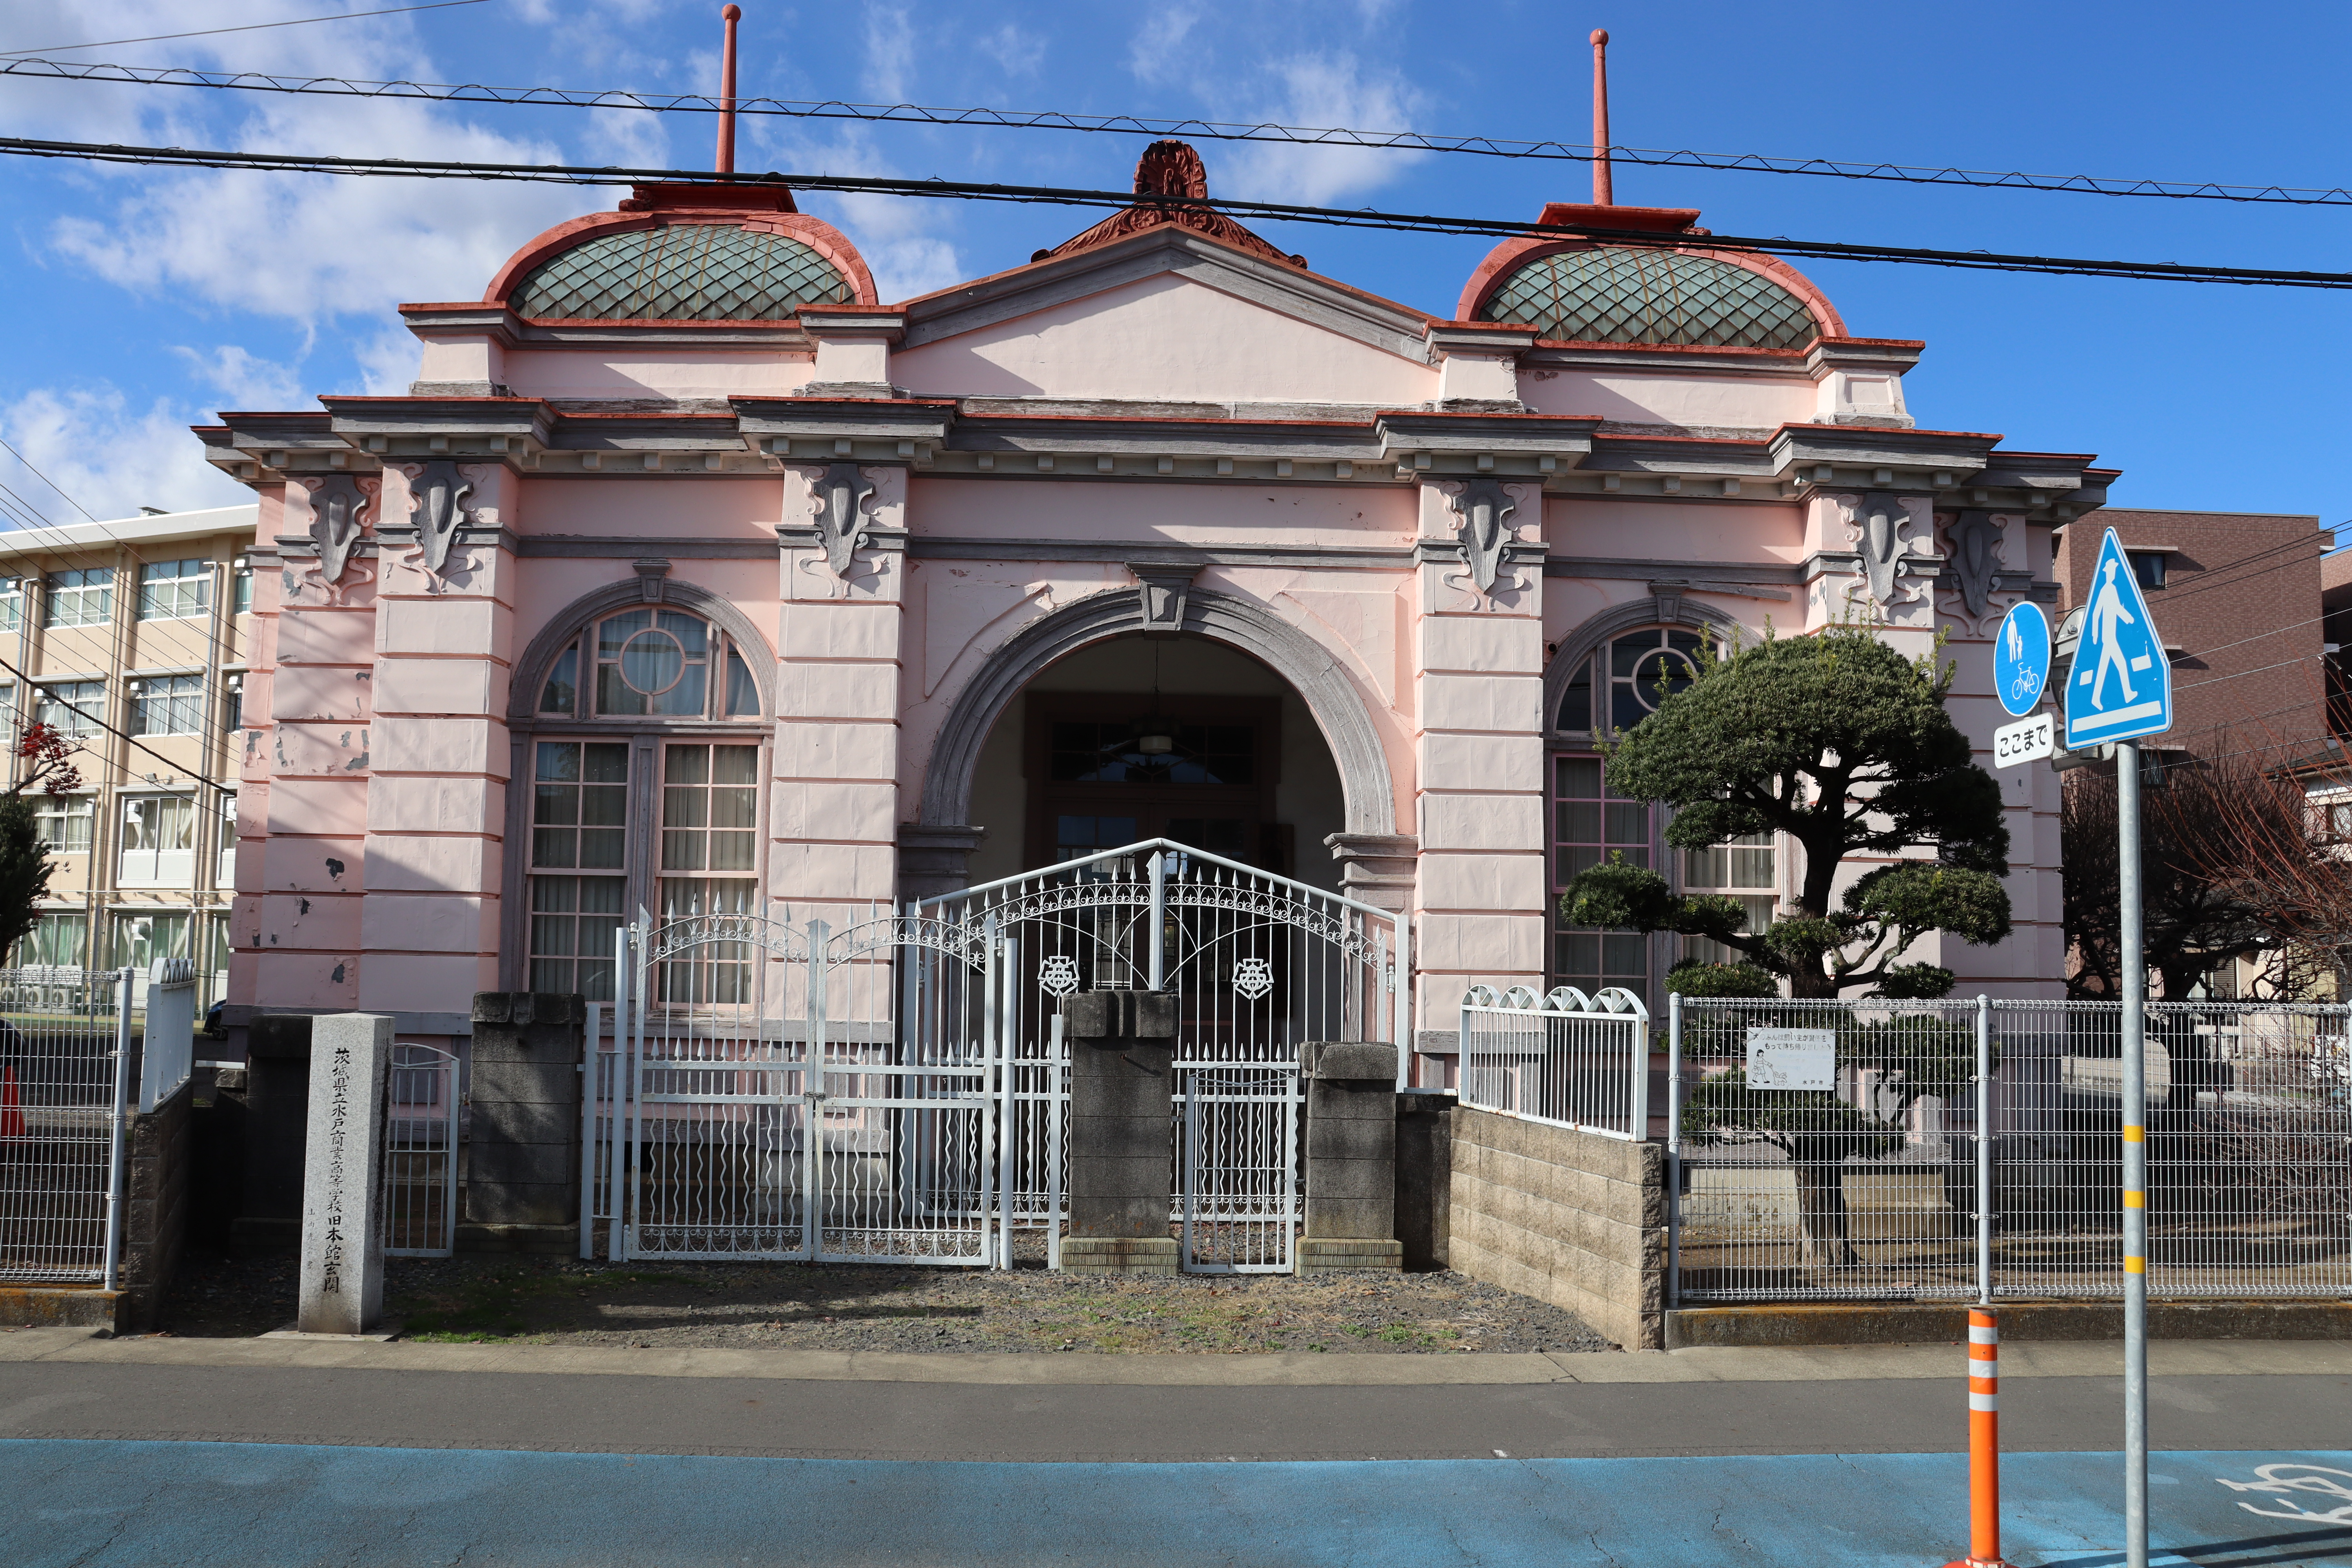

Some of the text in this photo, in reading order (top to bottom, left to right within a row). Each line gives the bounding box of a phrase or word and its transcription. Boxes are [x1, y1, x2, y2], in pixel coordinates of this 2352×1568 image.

[2000, 724, 2047, 757] ここまで
[324, 1047, 350, 1294] 茨城県立水戸商業高等学校旧本館玄関
